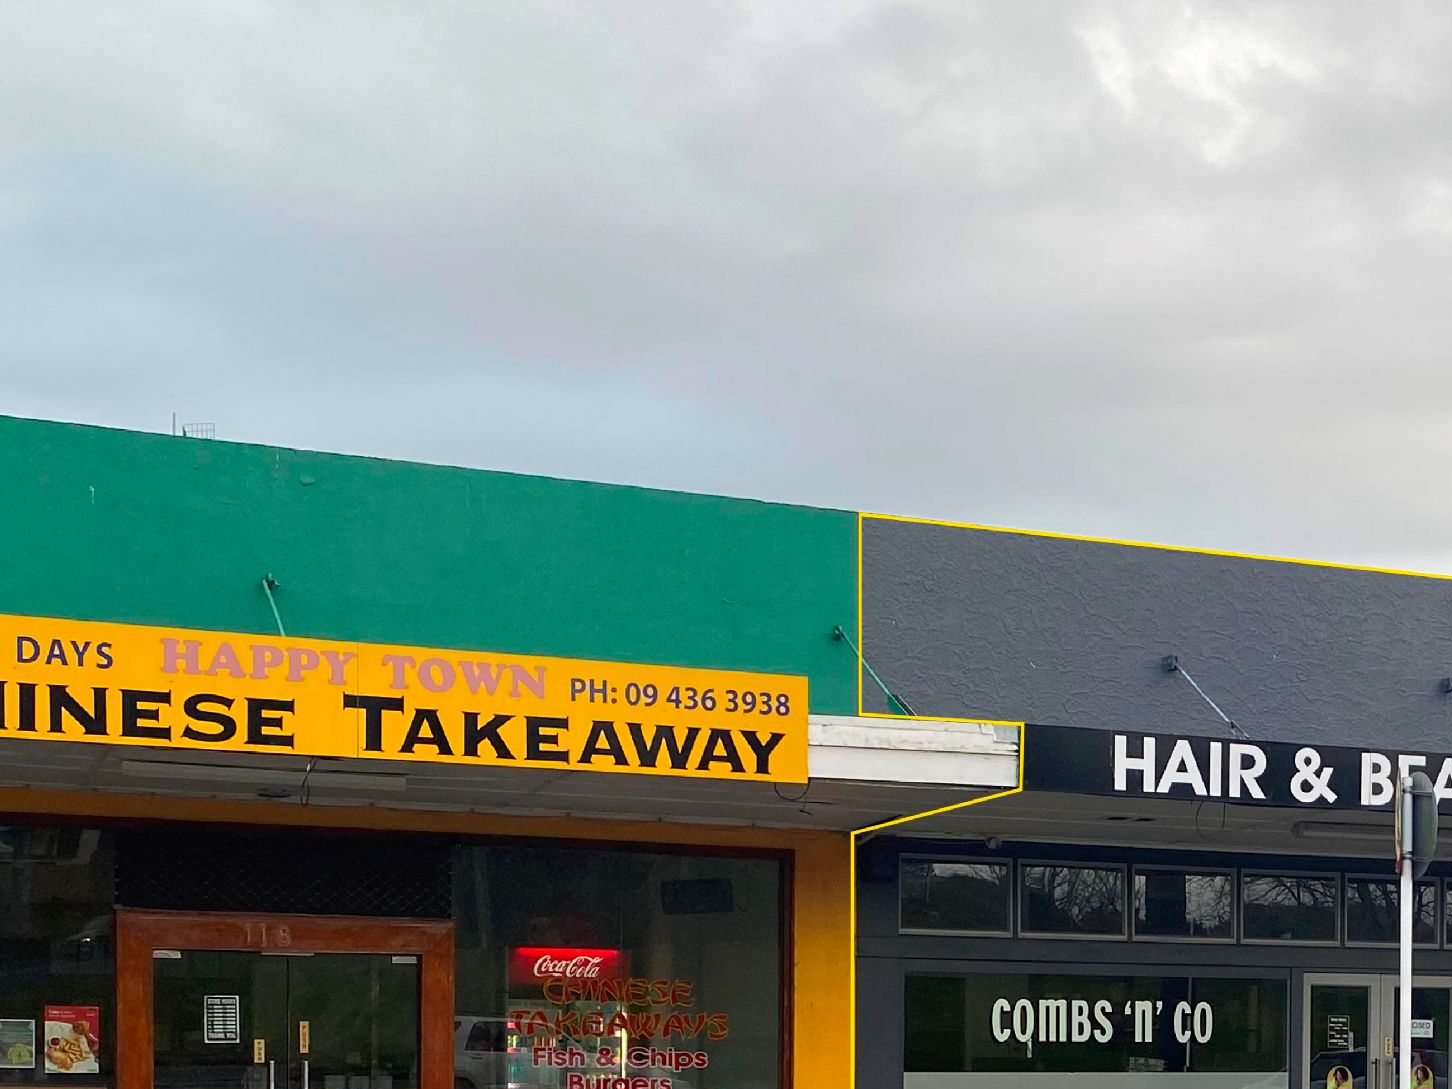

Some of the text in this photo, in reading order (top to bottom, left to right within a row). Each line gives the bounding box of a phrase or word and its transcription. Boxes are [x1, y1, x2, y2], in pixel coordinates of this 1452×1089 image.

[16, 635, 791, 717] DAYS HAPPY TOWN PH: 09 436 3938
[342, 690, 785, 776] TAKEAWAY
[1112, 733, 1268, 801] HAIR
[1290, 748, 1337, 804] &
[532, 954, 604, 978] Coca-Cola
[543, 977, 693, 1007] CHINESE
[508, 1009, 730, 1041] TAKEAWAYS
[1173, 1001, 1214, 1044] CO
[532, 1046, 709, 1073] Fish & Chips
